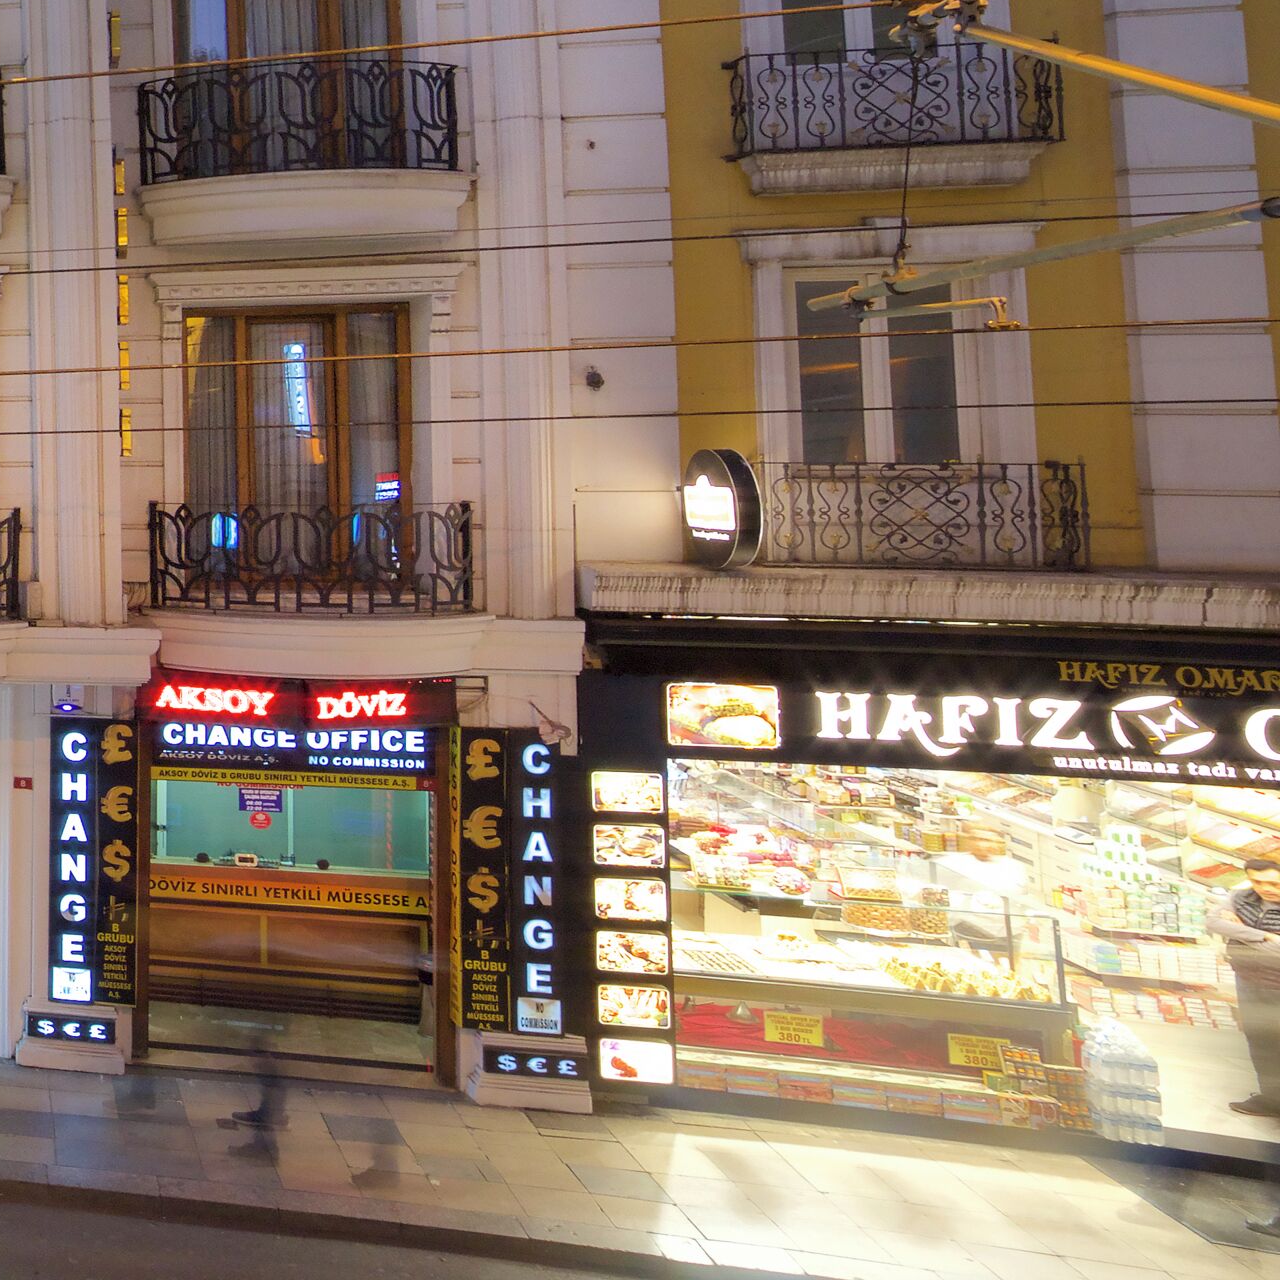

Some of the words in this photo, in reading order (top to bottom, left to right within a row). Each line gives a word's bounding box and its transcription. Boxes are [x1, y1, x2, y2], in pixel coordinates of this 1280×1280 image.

[1057, 660, 1168, 689] HAFIZ
[155, 684, 275, 716] AKSOY
[317, 690, 407, 719] DÖVİZ
[815, 690, 1096, 757] HAFIZ
[162, 722, 296, 748] CHANGE
[306, 729, 425, 752] OFFICE
[308, 756, 329, 766] NO
[332, 757, 425, 769] COMMISSION
[1053, 756, 1180, 775] unutulmaz
[1187, 762, 1237, 778] tadı
[160, 769, 188, 778] AKSOY
[191, 769, 218, 779] DÖVİZ
[230, 772, 261, 781] GRUBU
[264, 773, 297, 782] SINIRLI
[300, 774, 336, 783] YETKİLİ
[340, 775, 390, 786] MÜESSESE
[59, 731, 88, 962] CHANGE
[521, 743, 553, 994] CHANGE
[202, 883, 257, 897] SINIRLI
[263, 886, 320, 901] YETKİLİ
[327, 888, 409, 907] MÜESSESE
[112, 923, 119, 932] B
[97, 932, 134, 944] GRUBU
[104, 945, 127, 953] AKSOY
[481, 950, 489, 959] B
[464, 959, 507, 972] GRUBU
[472, 973, 497, 982] AKSOY
[536, 1001, 544, 1013] NO
[521, 1016, 558, 1030] COMMISSION
[778, 1032, 801, 1042] 380
[964, 1055, 988, 1066] 380
